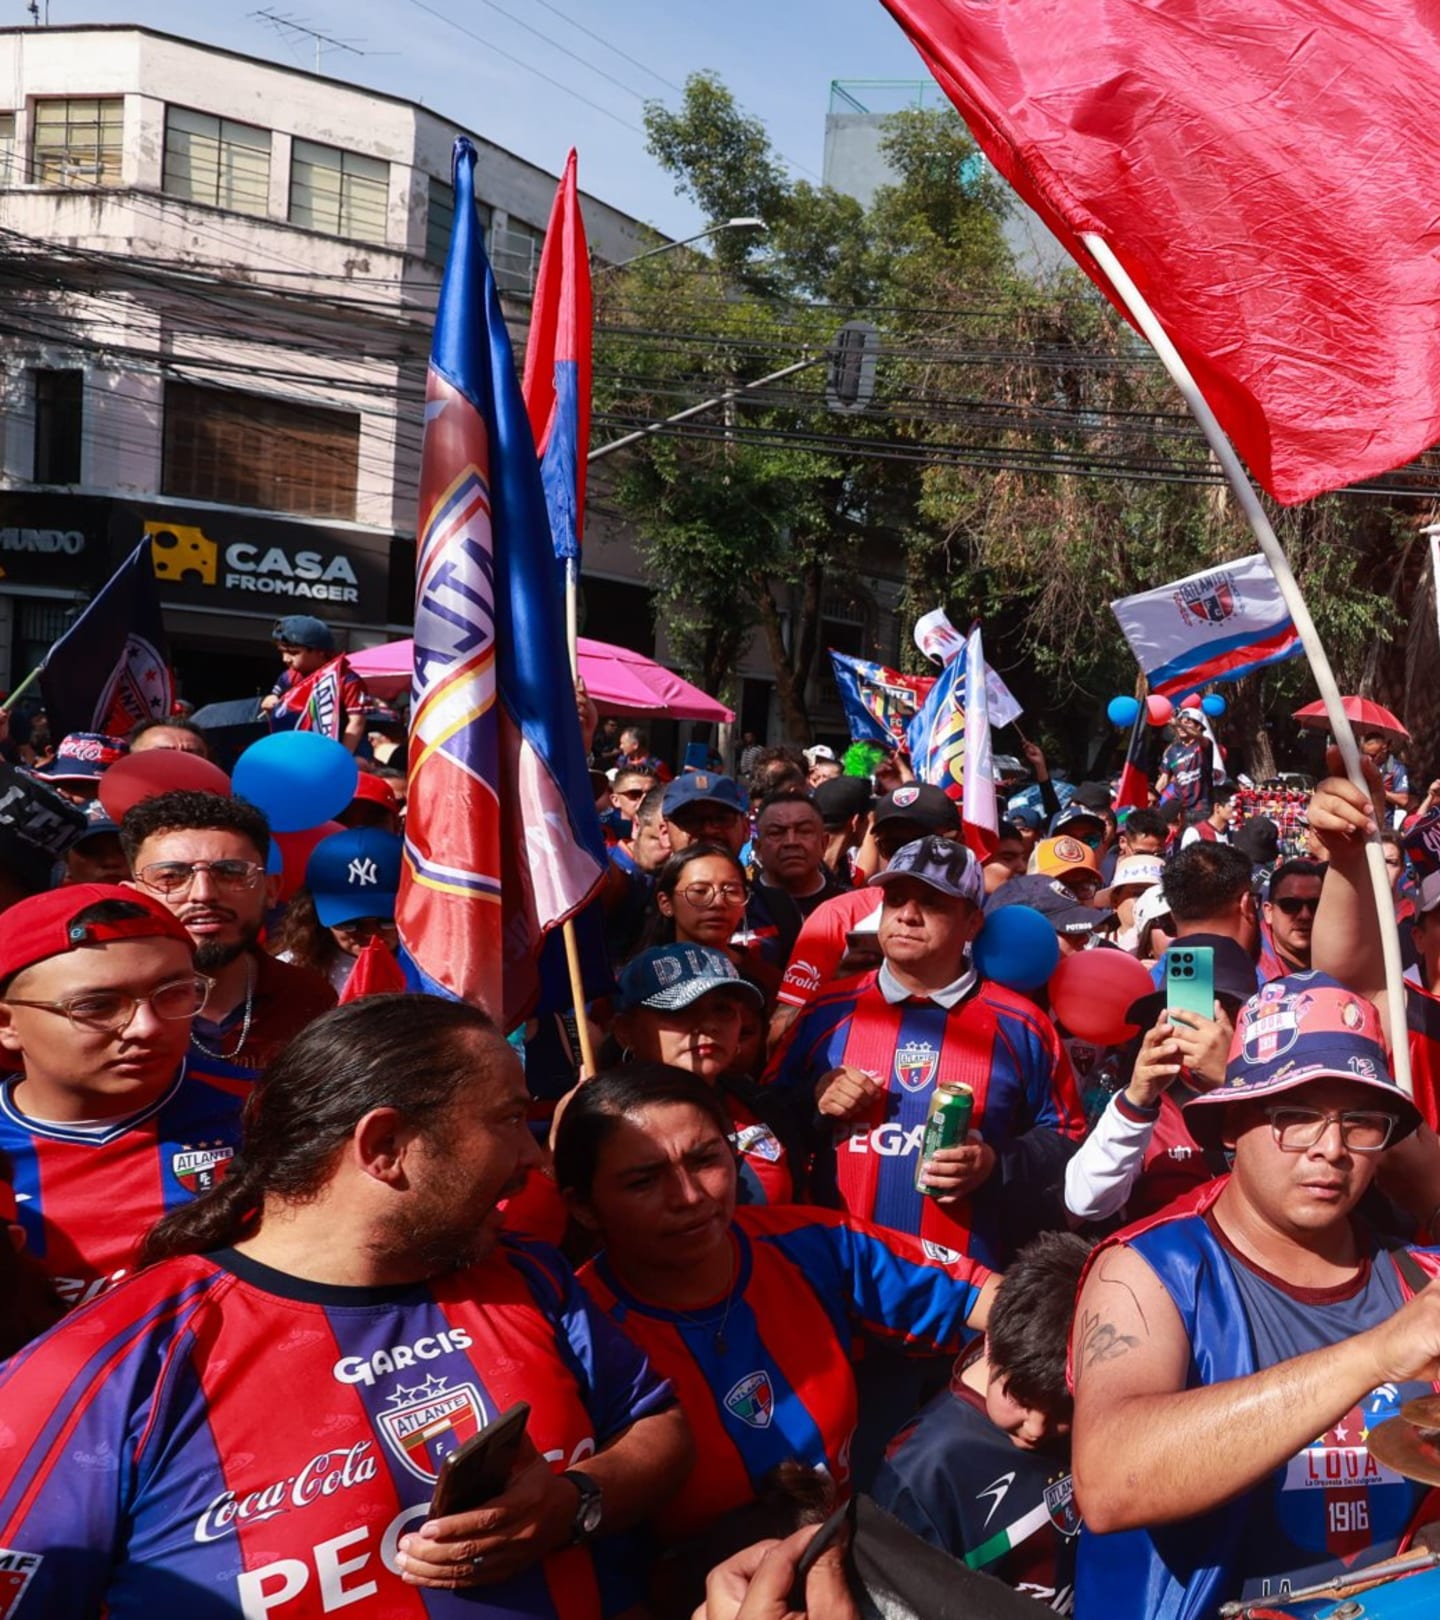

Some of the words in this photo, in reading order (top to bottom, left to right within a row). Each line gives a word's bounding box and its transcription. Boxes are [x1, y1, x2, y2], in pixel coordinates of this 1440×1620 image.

[225, 542, 358, 584] CASA
[225, 574, 359, 602] FROMAGER
[347, 857, 377, 887] NY
[1065, 922, 1093, 932] POTROS
[177, 1149, 233, 1170] ATLANTE
[333, 1328, 473, 1386] GARCIS
[399, 1395, 466, 1437] ATLANTE
[1308, 1450, 1378, 1480] LODA
[194, 1440, 378, 1543] Coca-Cola
[1328, 1500, 1369, 1532] 1916
